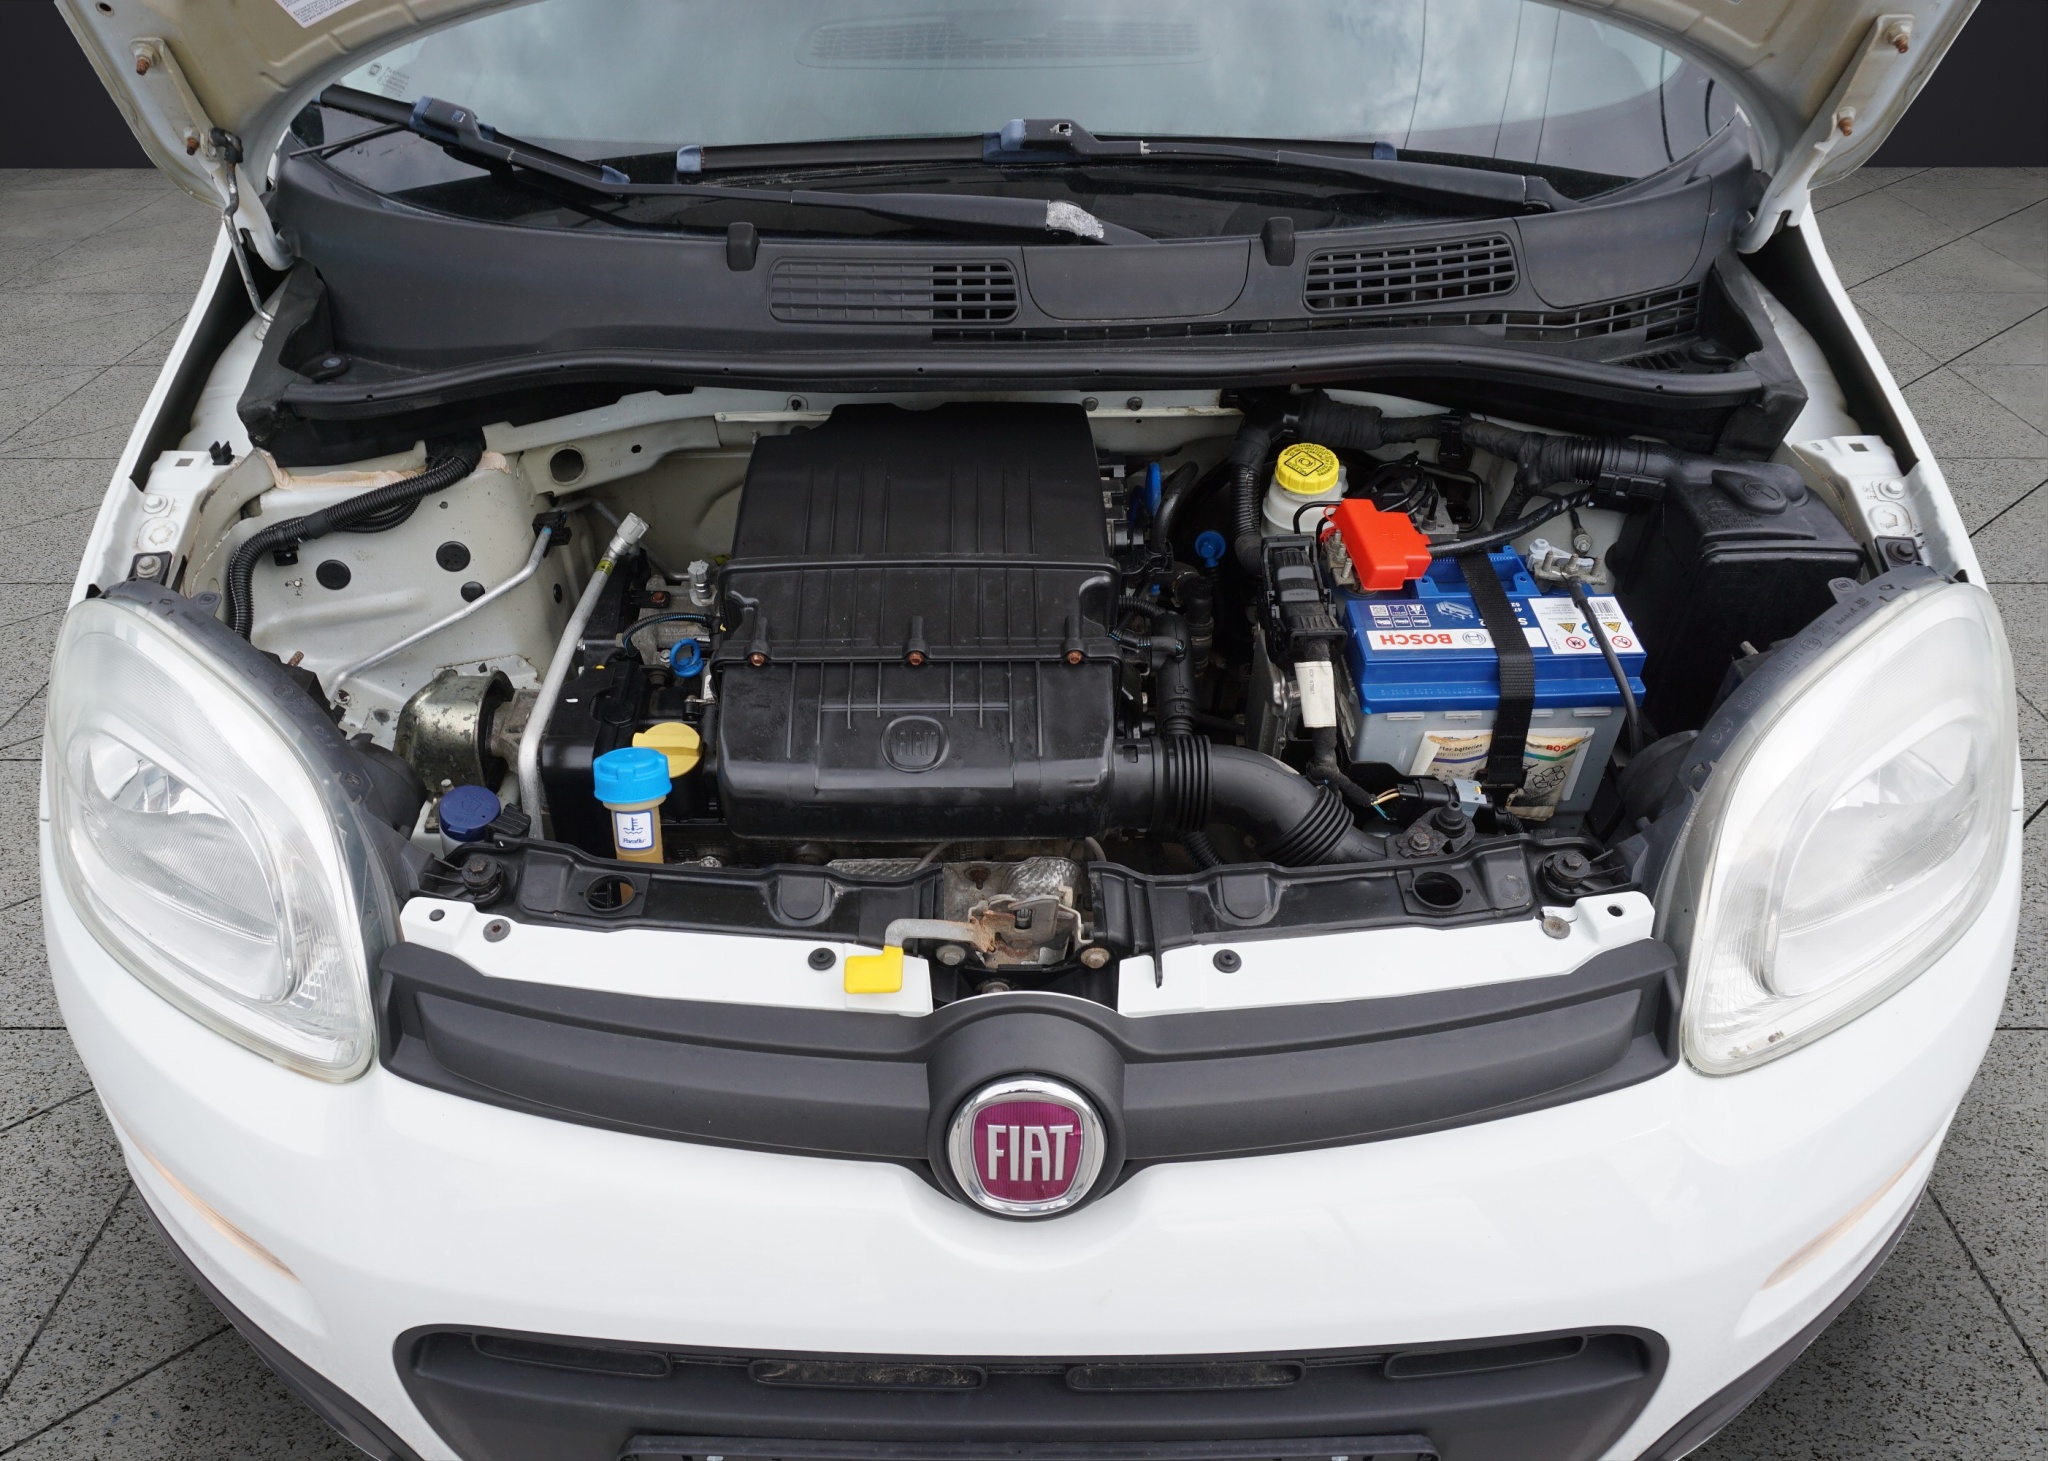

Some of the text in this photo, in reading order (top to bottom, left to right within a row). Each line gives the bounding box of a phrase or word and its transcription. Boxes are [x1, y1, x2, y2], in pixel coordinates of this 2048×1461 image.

[1379, 633, 1453, 647] BOSCH
[896, 731, 936, 757] FIAT
[1454, 743, 1483, 752] batteries
[1546, 744, 1568, 752] BOS
[987, 1124, 1074, 1182] FIAT
